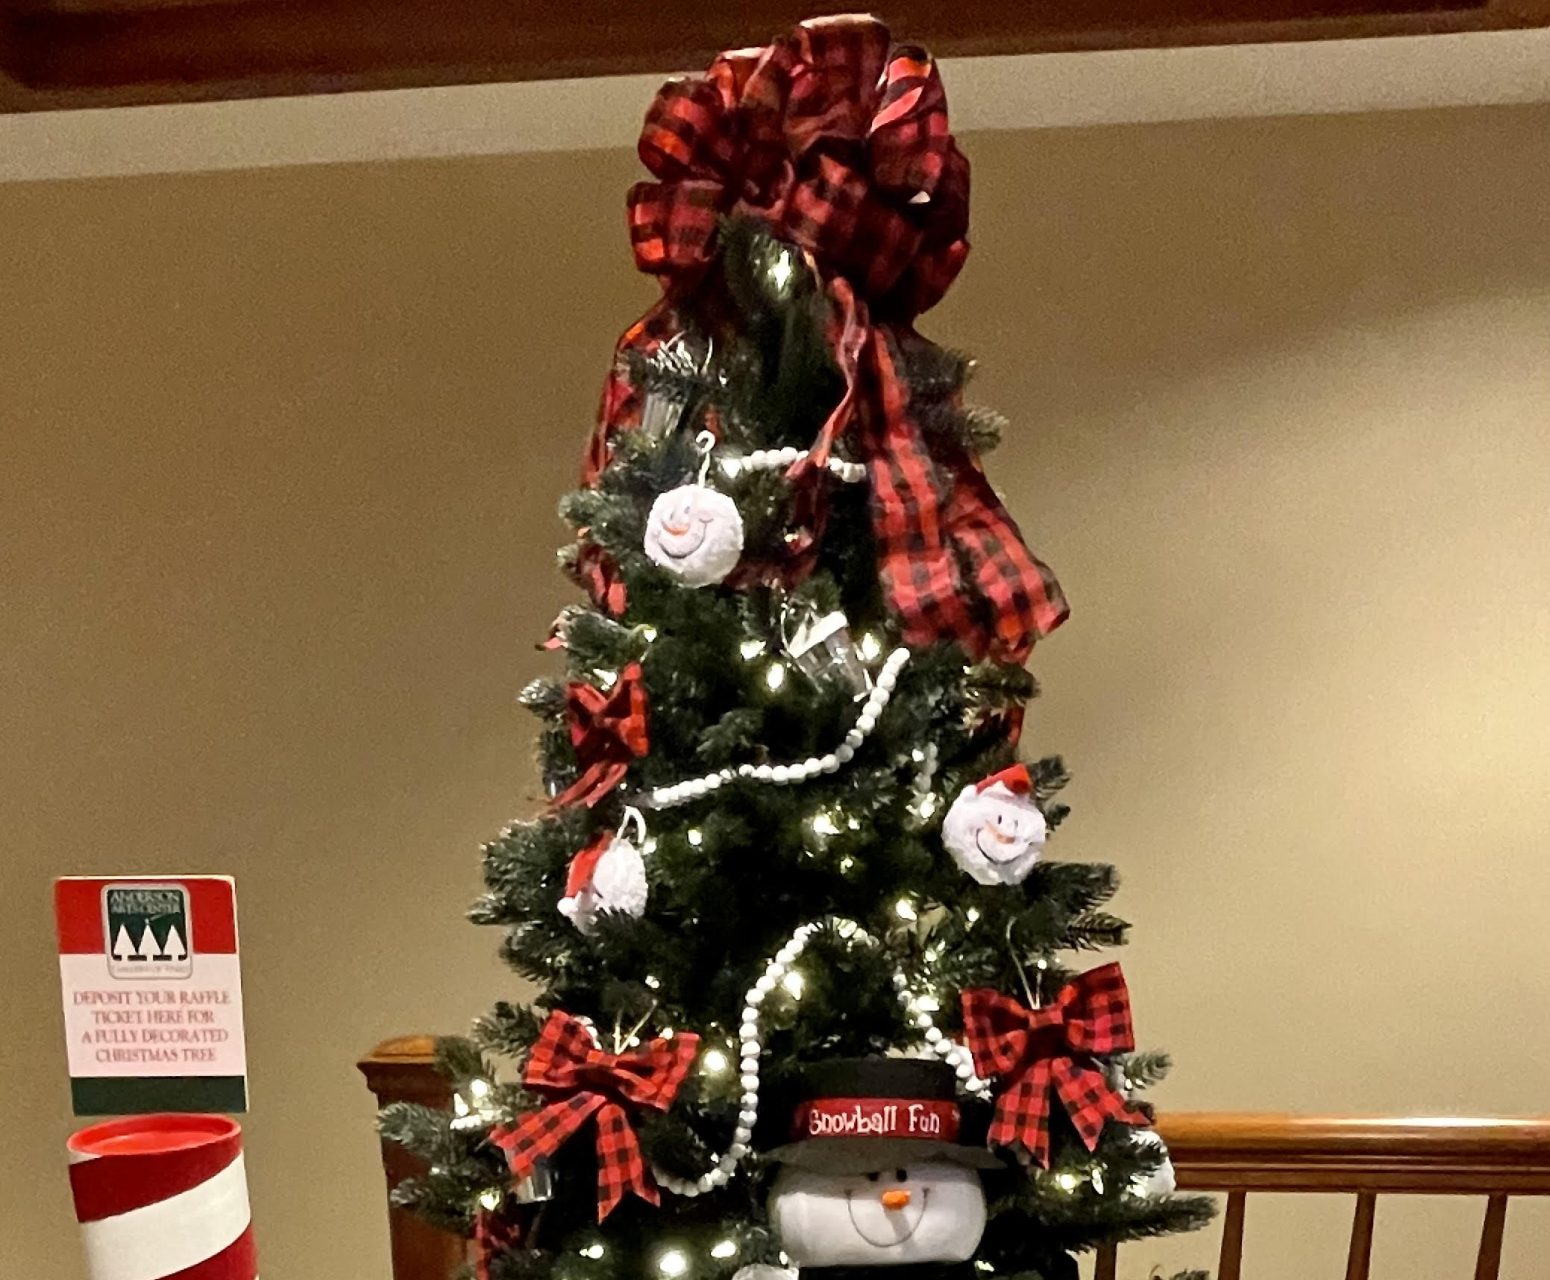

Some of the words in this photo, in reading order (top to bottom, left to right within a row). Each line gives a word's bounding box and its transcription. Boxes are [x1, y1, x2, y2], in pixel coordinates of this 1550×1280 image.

[73, 991, 131, 1006] DEPOSIT
[135, 990, 176, 1005] YOUR
[179, 990, 231, 1004] RAFFLE
[92, 1010, 143, 1025] TICKET
[147, 1010, 183, 1024] HERE
[187, 1010, 215, 1024] FOR
[81, 1031, 92, 1044] A
[95, 1030, 138, 1044] FULLY
[142, 1029, 229, 1044] DECORATED
[95, 1049, 178, 1063] CHRISTMAS
[183, 1048, 217, 1062] TREE
[809, 1104, 898, 1135] Snowball
[908, 1103, 940, 1134] Fun
